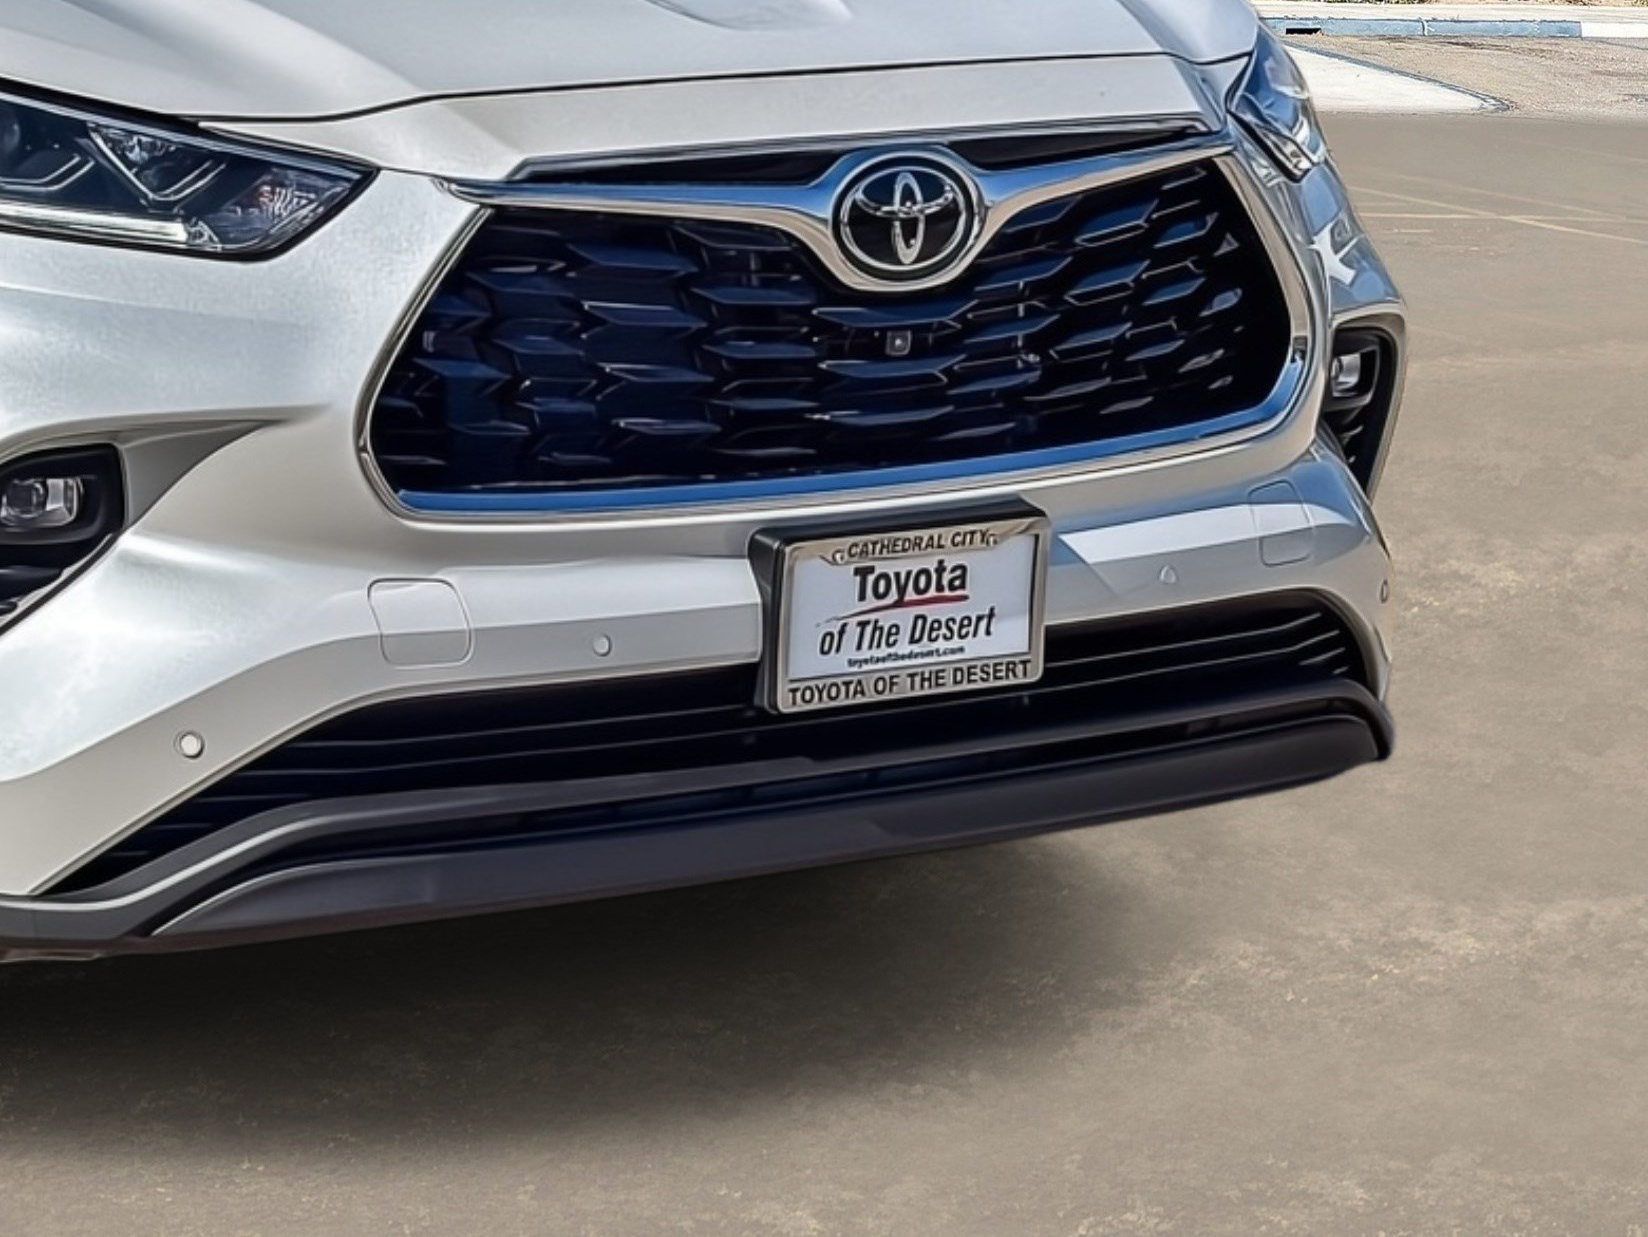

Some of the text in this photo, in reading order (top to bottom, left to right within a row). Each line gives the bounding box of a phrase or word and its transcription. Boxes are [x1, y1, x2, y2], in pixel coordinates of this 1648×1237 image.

[847, 528, 990, 558] CATHEDRAL CITY
[853, 559, 968, 604] Toyota
[819, 606, 996, 655] of The Desert
[788, 660, 1032, 706] TOYOTA OF THE DESERT
